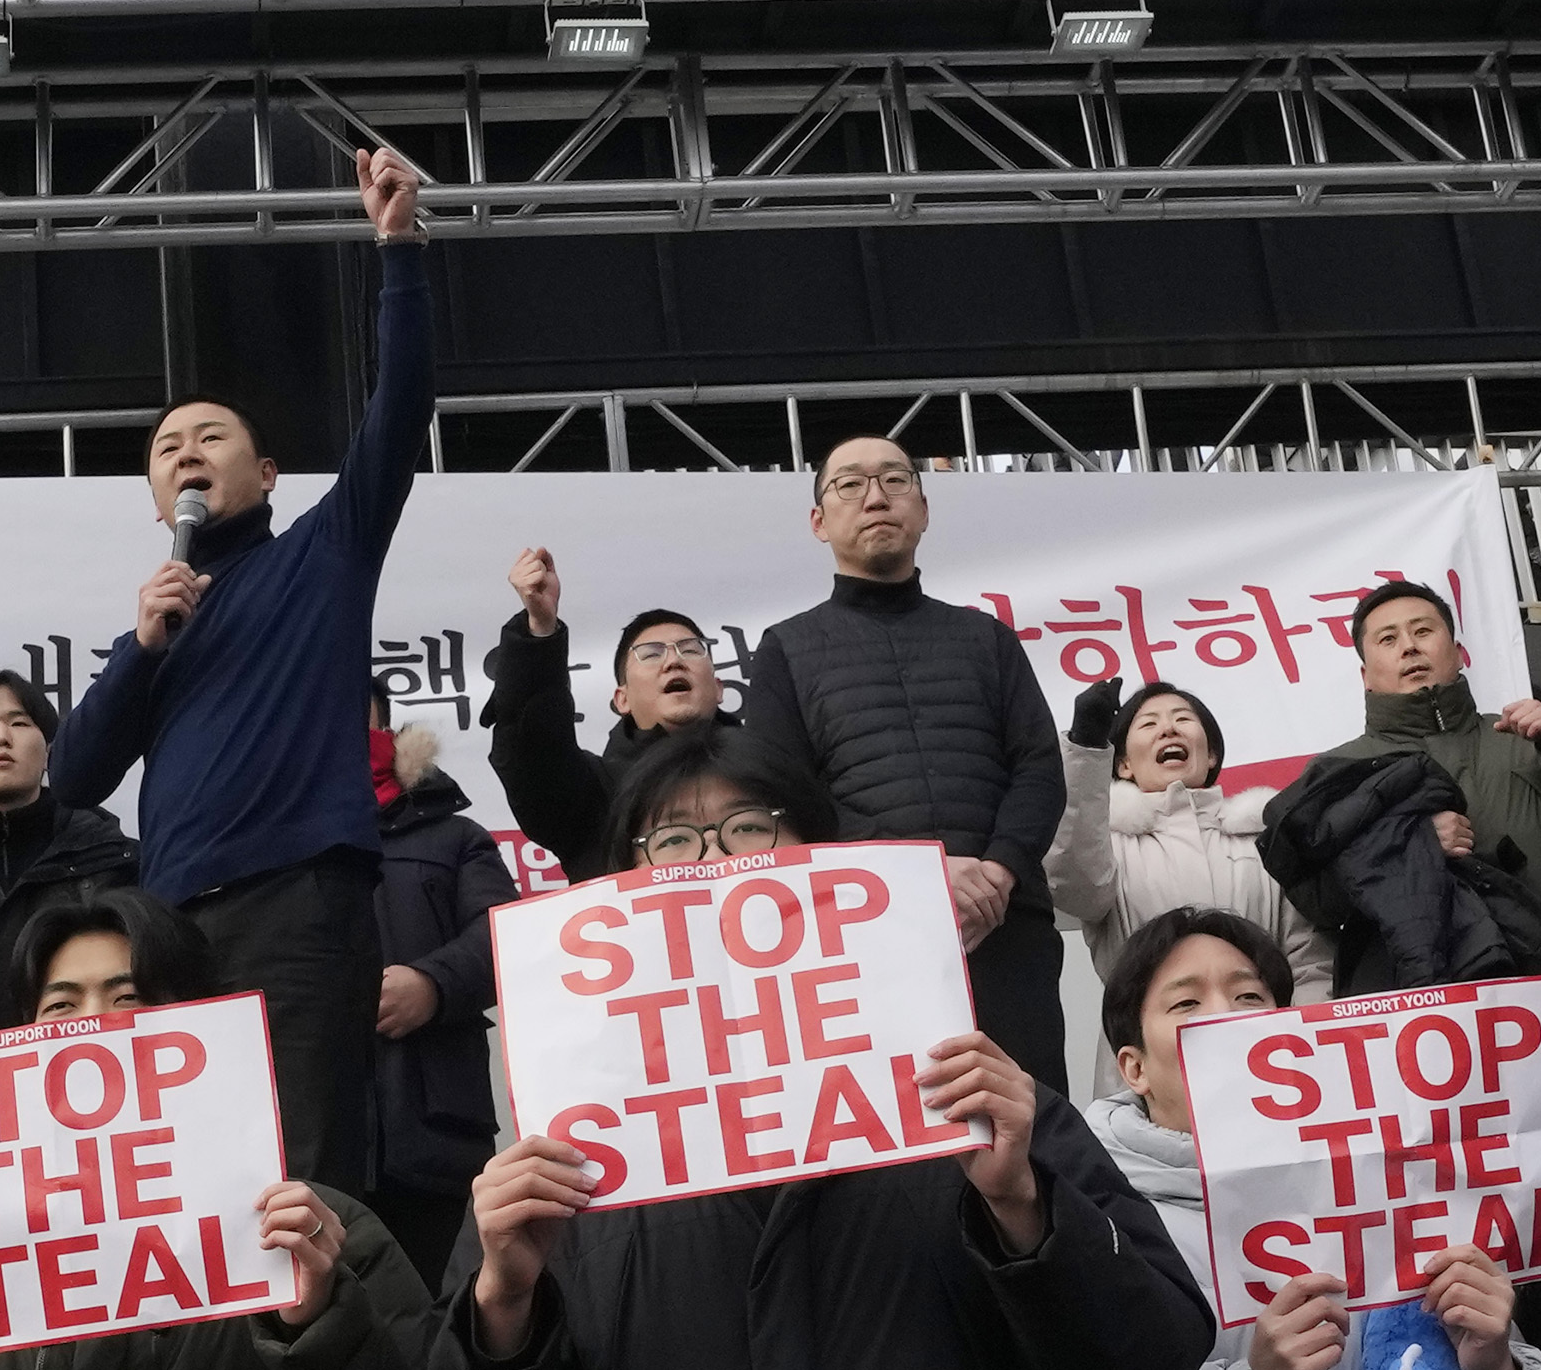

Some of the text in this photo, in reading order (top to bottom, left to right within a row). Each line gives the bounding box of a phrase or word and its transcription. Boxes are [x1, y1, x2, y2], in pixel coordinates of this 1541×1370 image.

[651, 851, 777, 883] SUPPORT YOON
[559, 868, 890, 996] STOP
[55, 1017, 102, 1037] YOON
[606, 963, 873, 1086] THE
[1332, 989, 1447, 1018] SUPPORT YOON
[546, 1054, 971, 1199] STEAL
[1298, 1099, 1522, 1208] THE
